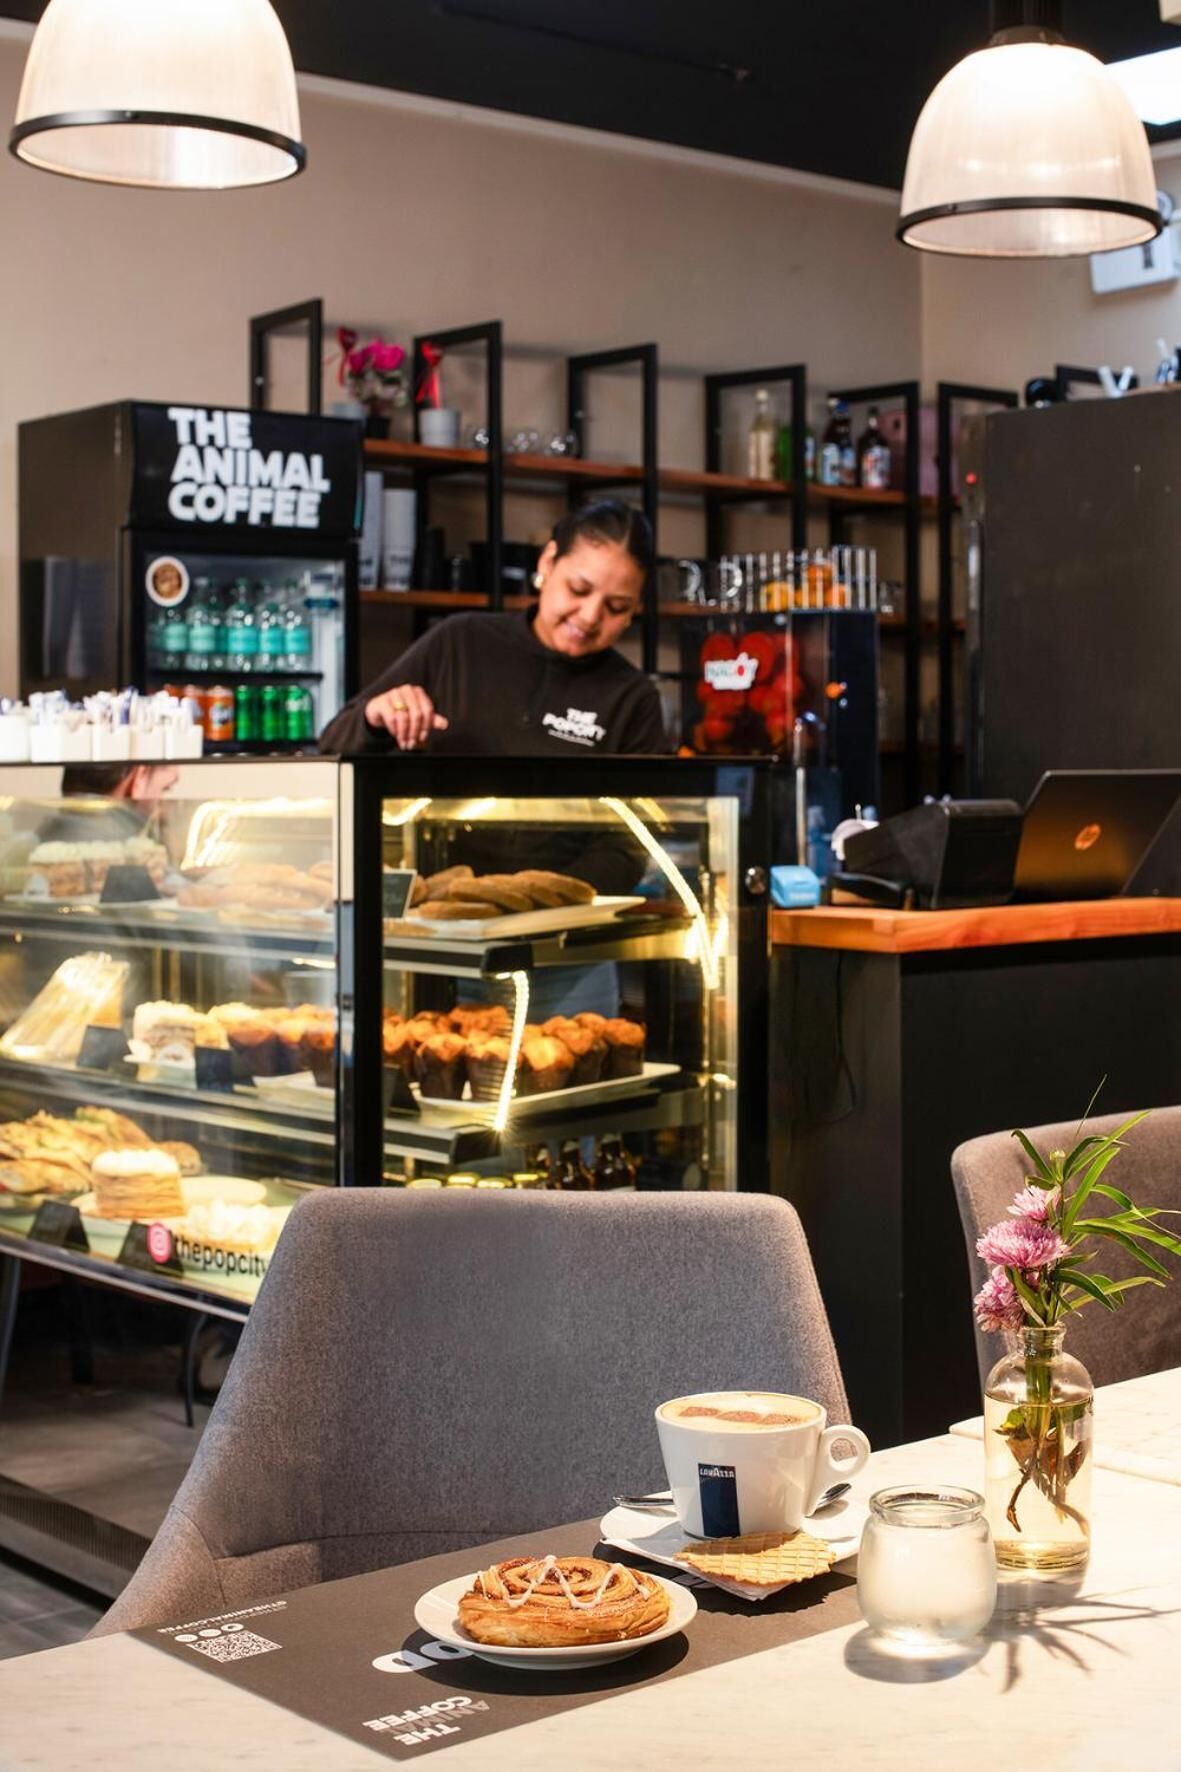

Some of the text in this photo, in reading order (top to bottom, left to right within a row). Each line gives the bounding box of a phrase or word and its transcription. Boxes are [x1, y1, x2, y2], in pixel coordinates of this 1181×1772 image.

[167, 407, 252, 448] THE
[170, 444, 331, 493] ANIMAL
[168, 481, 321, 529] COFFEE
[699, 1467, 735, 1479] LAVAZZA
[362, 1696, 473, 1731] COFFEE
[379, 1699, 490, 1735] ANIMAL
[392, 1723, 461, 1746] THE
